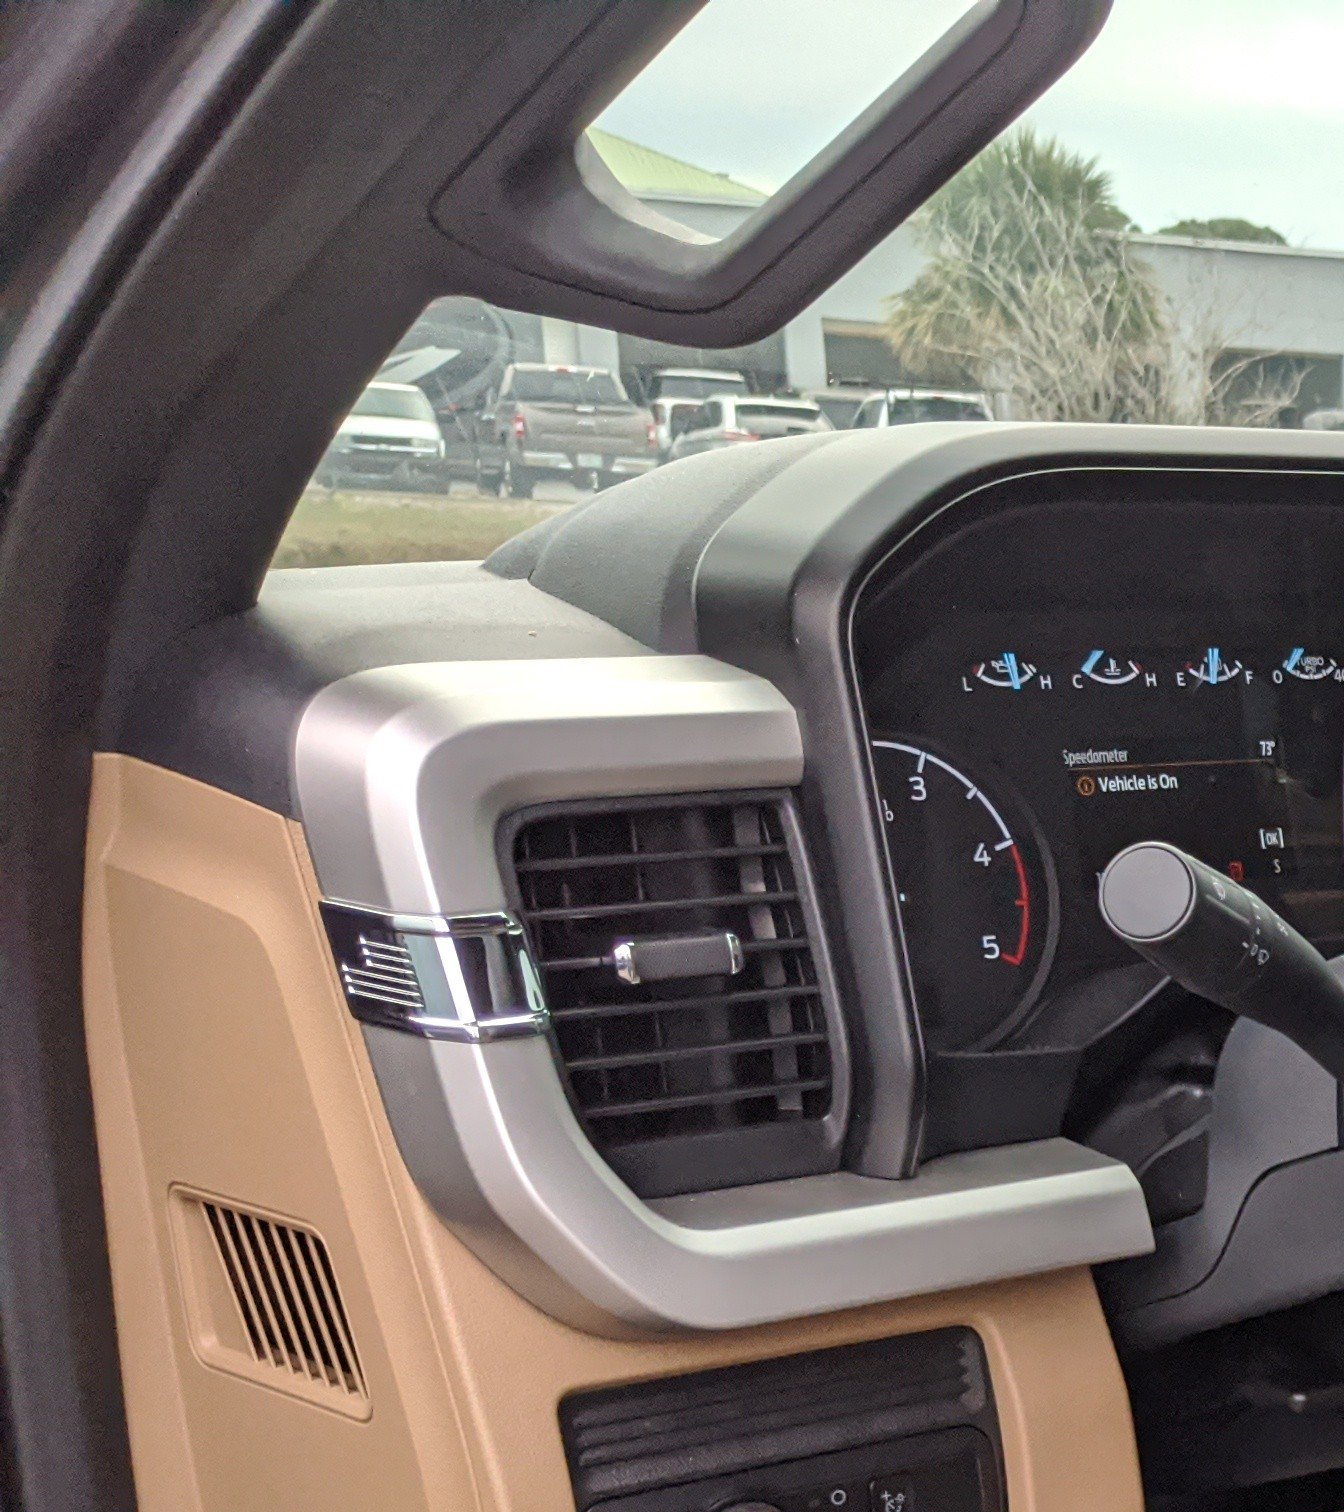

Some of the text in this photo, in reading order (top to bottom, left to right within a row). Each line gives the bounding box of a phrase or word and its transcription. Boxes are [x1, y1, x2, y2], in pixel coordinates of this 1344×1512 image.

[962, 676, 972, 691] L
[1041, 675, 1052, 689] H
[1073, 675, 1083, 689] C
[1146, 673, 1157, 687] H
[1177, 673, 1186, 686] E
[1245, 670, 1253, 684] F
[1063, 749, 1128, 768] Speedometer
[908, 776, 927, 801] 3
[1098, 774, 1178, 793] Vehicle is On
[973, 842, 991, 867] 4
[982, 935, 1000, 959] 5
